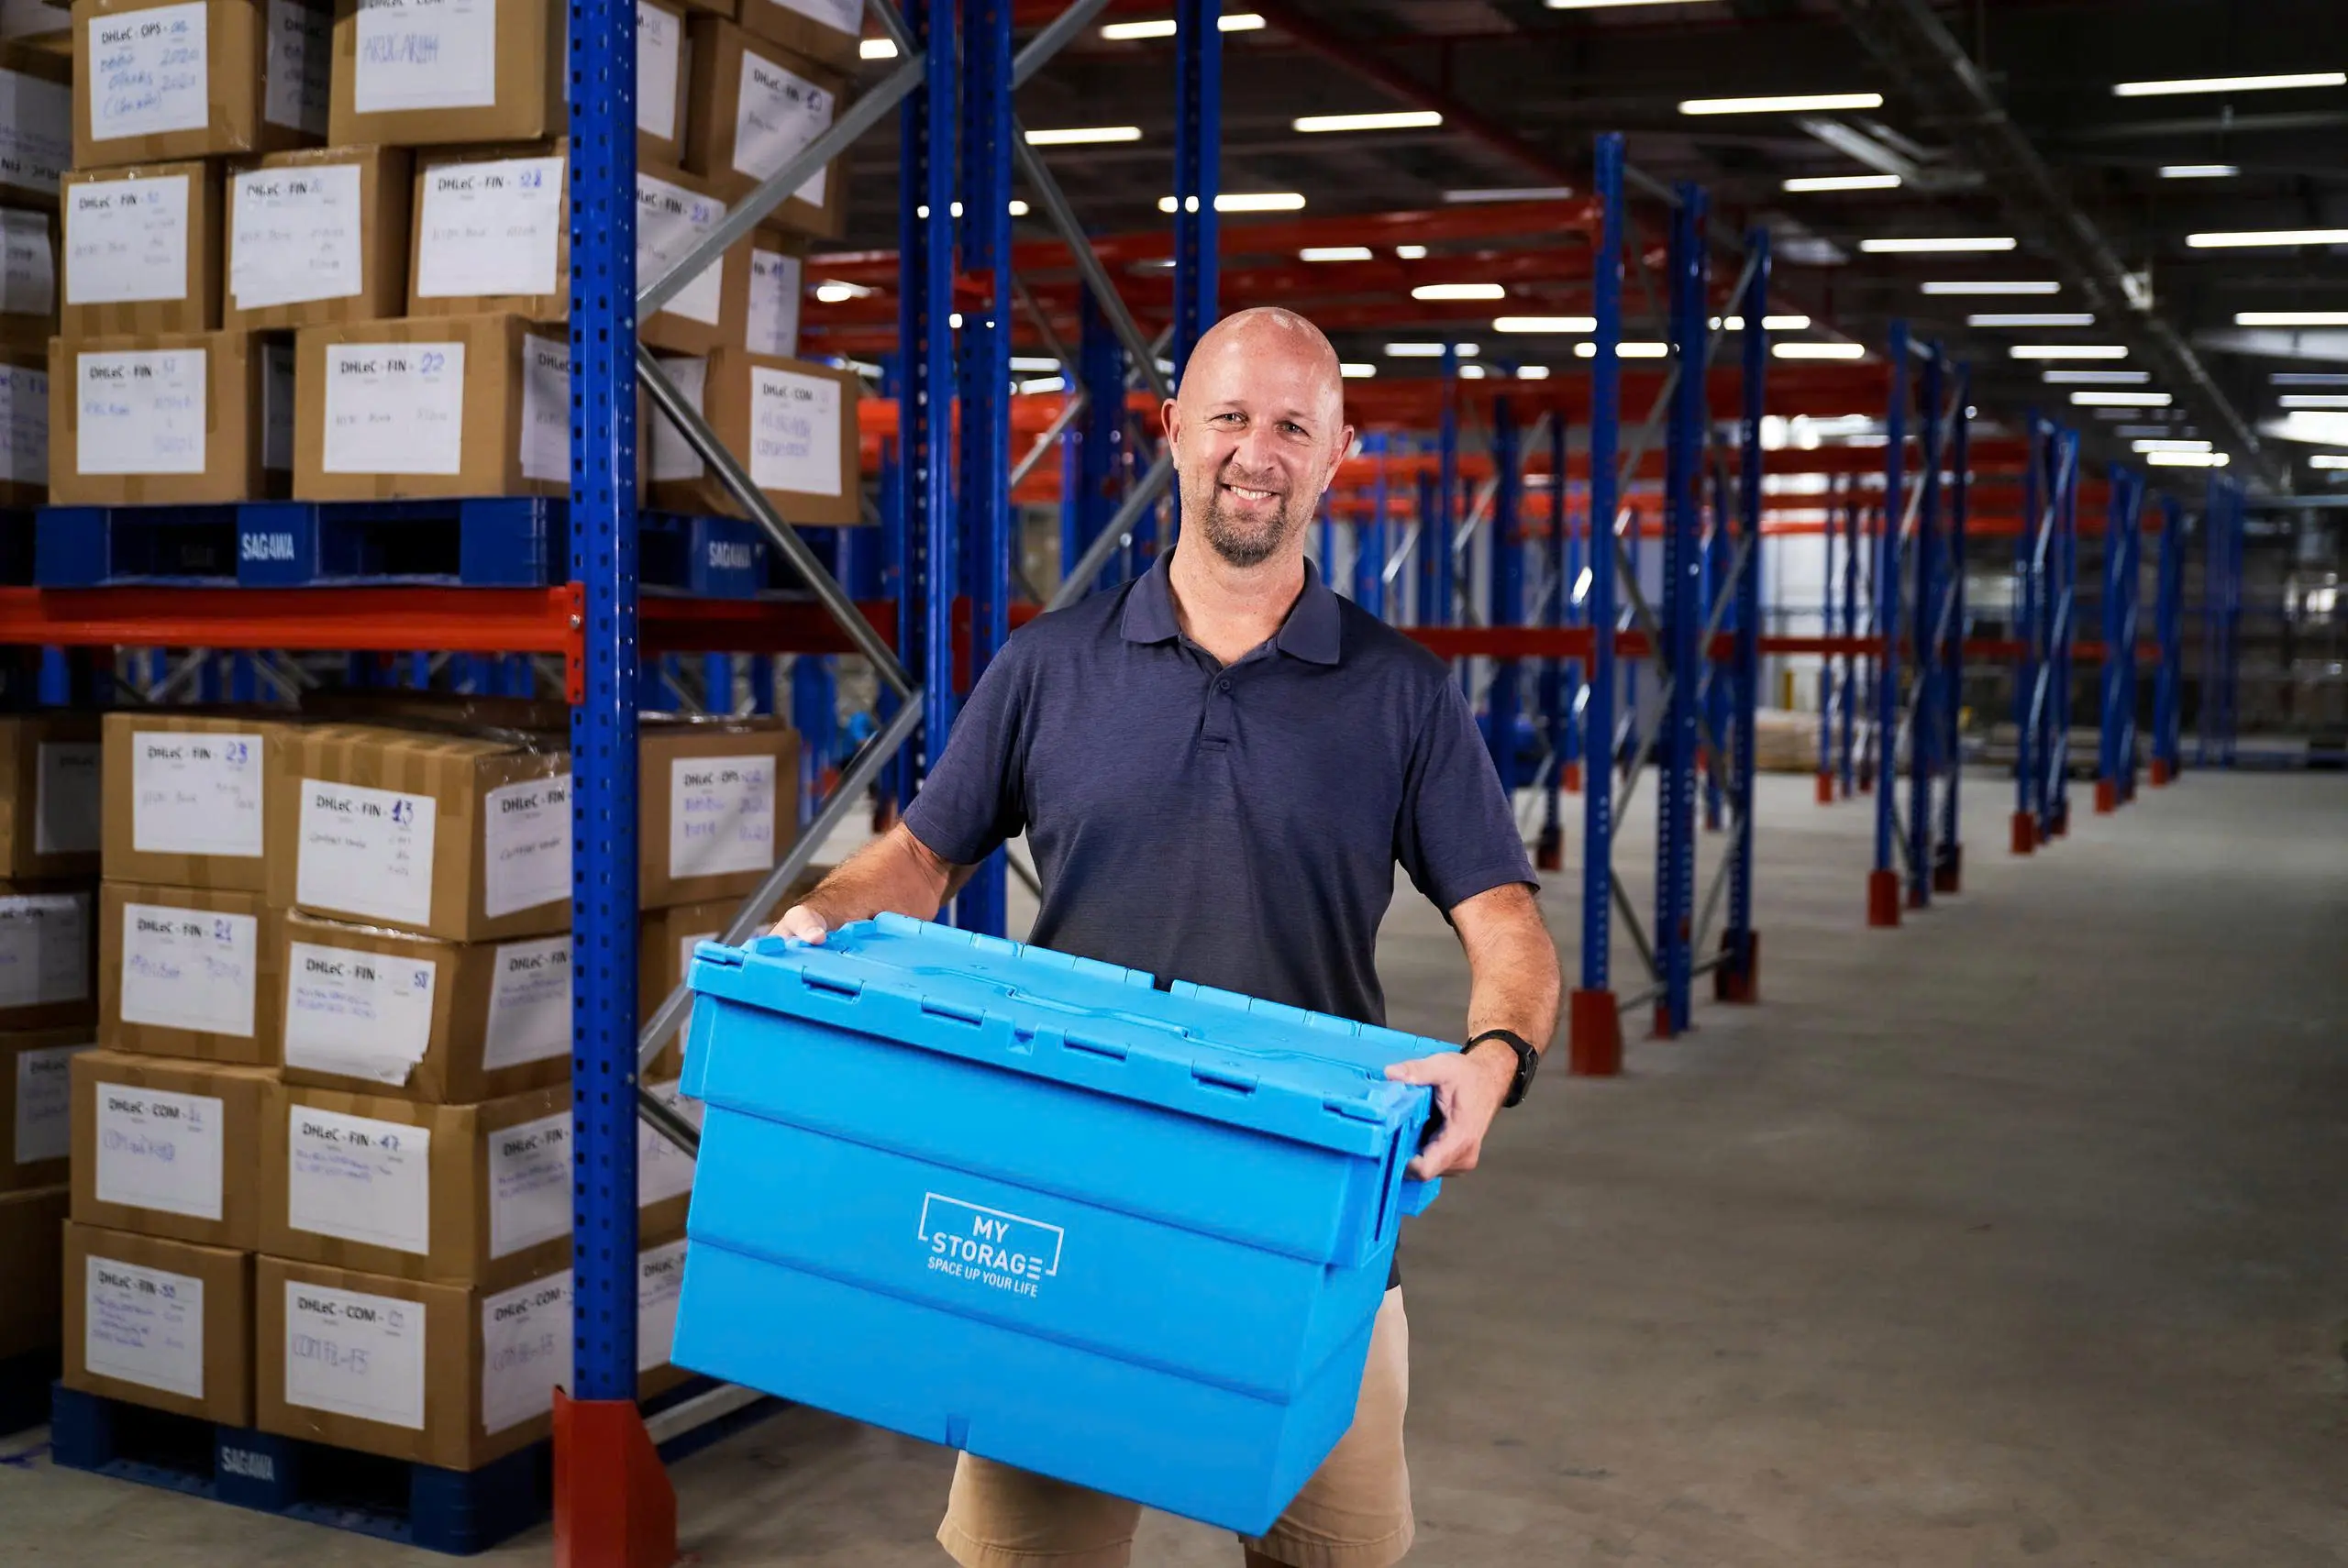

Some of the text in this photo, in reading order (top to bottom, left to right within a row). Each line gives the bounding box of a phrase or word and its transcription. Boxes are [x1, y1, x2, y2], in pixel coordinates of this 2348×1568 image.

[387, 359, 406, 373] FIN
[420, 352, 445, 374] 22
[242, 533, 294, 561] SAGAWA
[354, 965, 375, 981] FIN
[349, 1129, 371, 1147] FIN
[972, 1215, 1010, 1243] MY
[931, 1231, 1043, 1280] STORAGE
[927, 1256, 1038, 1298] SPACE UP YOUR LIFE
[346, 1304, 376, 1323] COM
